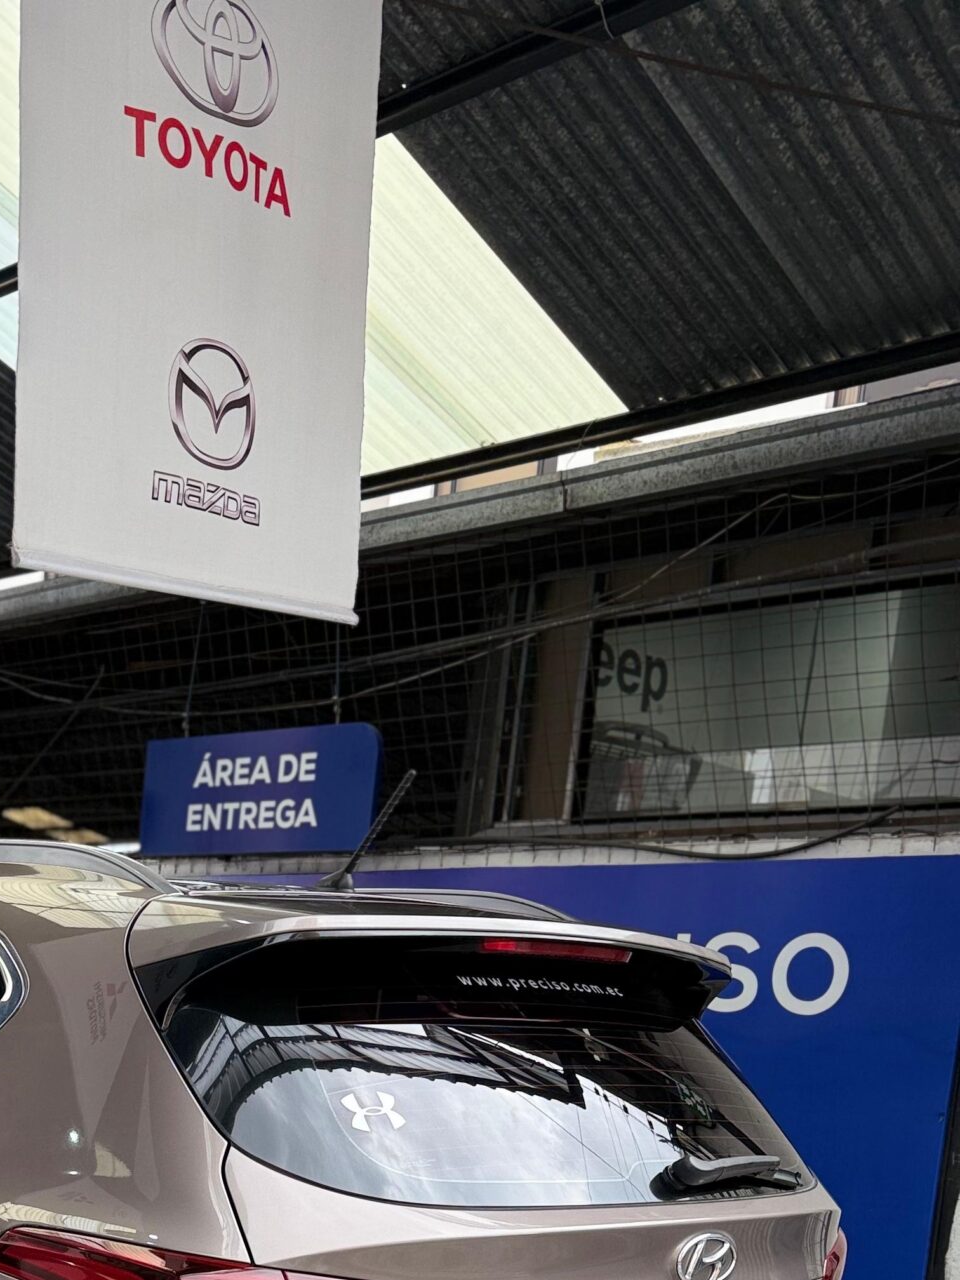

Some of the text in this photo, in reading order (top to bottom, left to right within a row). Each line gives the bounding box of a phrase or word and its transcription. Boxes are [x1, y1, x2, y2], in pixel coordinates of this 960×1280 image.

[123, 105, 291, 218] TOYOTA
[193, 752, 318, 788] ÁREA DE
[185, 799, 318, 832] ENTREGA
[456, 975, 624, 997] www.preciso.com.ec
[677, 931, 850, 1016] SO
